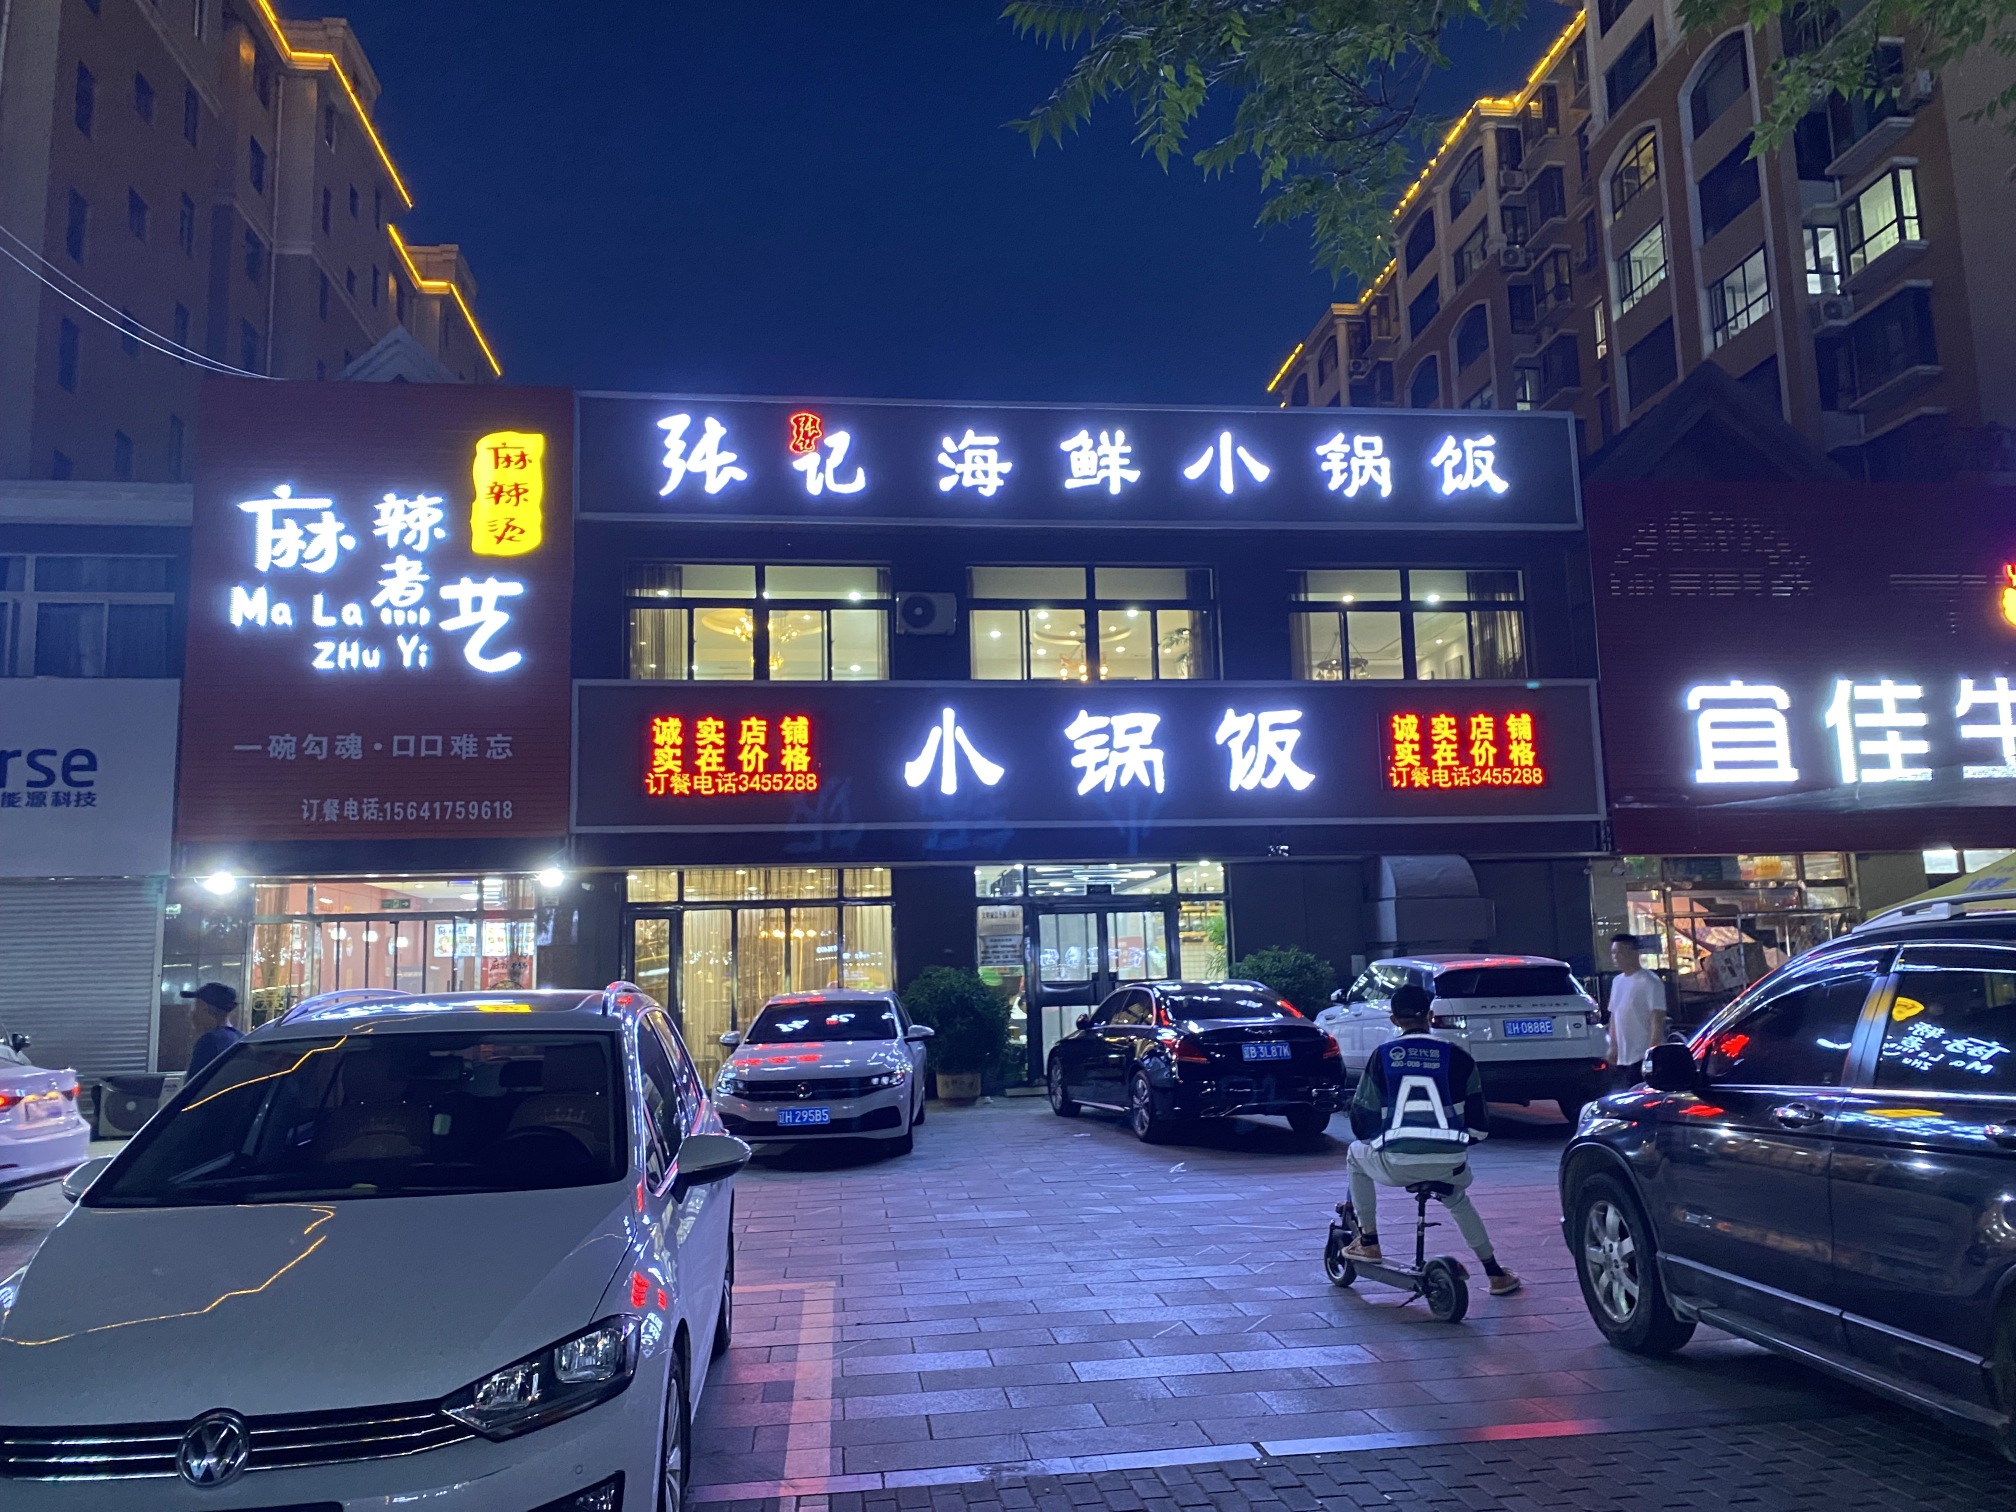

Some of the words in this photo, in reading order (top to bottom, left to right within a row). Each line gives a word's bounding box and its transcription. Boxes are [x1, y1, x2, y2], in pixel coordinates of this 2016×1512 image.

[656, 412, 1510, 497] 张记海鲜小锅饭
[486, 442, 533, 545] 麻辣烫
[230, 586, 293, 629] Ma
[312, 593, 363, 628] La
[397, 634, 430, 669] Yi
[652, 716, 811, 746] 诚实店铺
[1392, 713, 1534, 741] 诚实店铺
[652, 744, 812, 773] 实在价格
[904, 706, 1316, 796] 小锅饭
[1394, 740, 1536, 768] 实在价格
[645, 772, 818, 796] 订餐电话3455288
[1390, 766, 1544, 788] 订餐电话3455288
[1, 791, 97, 808] 能源科技
